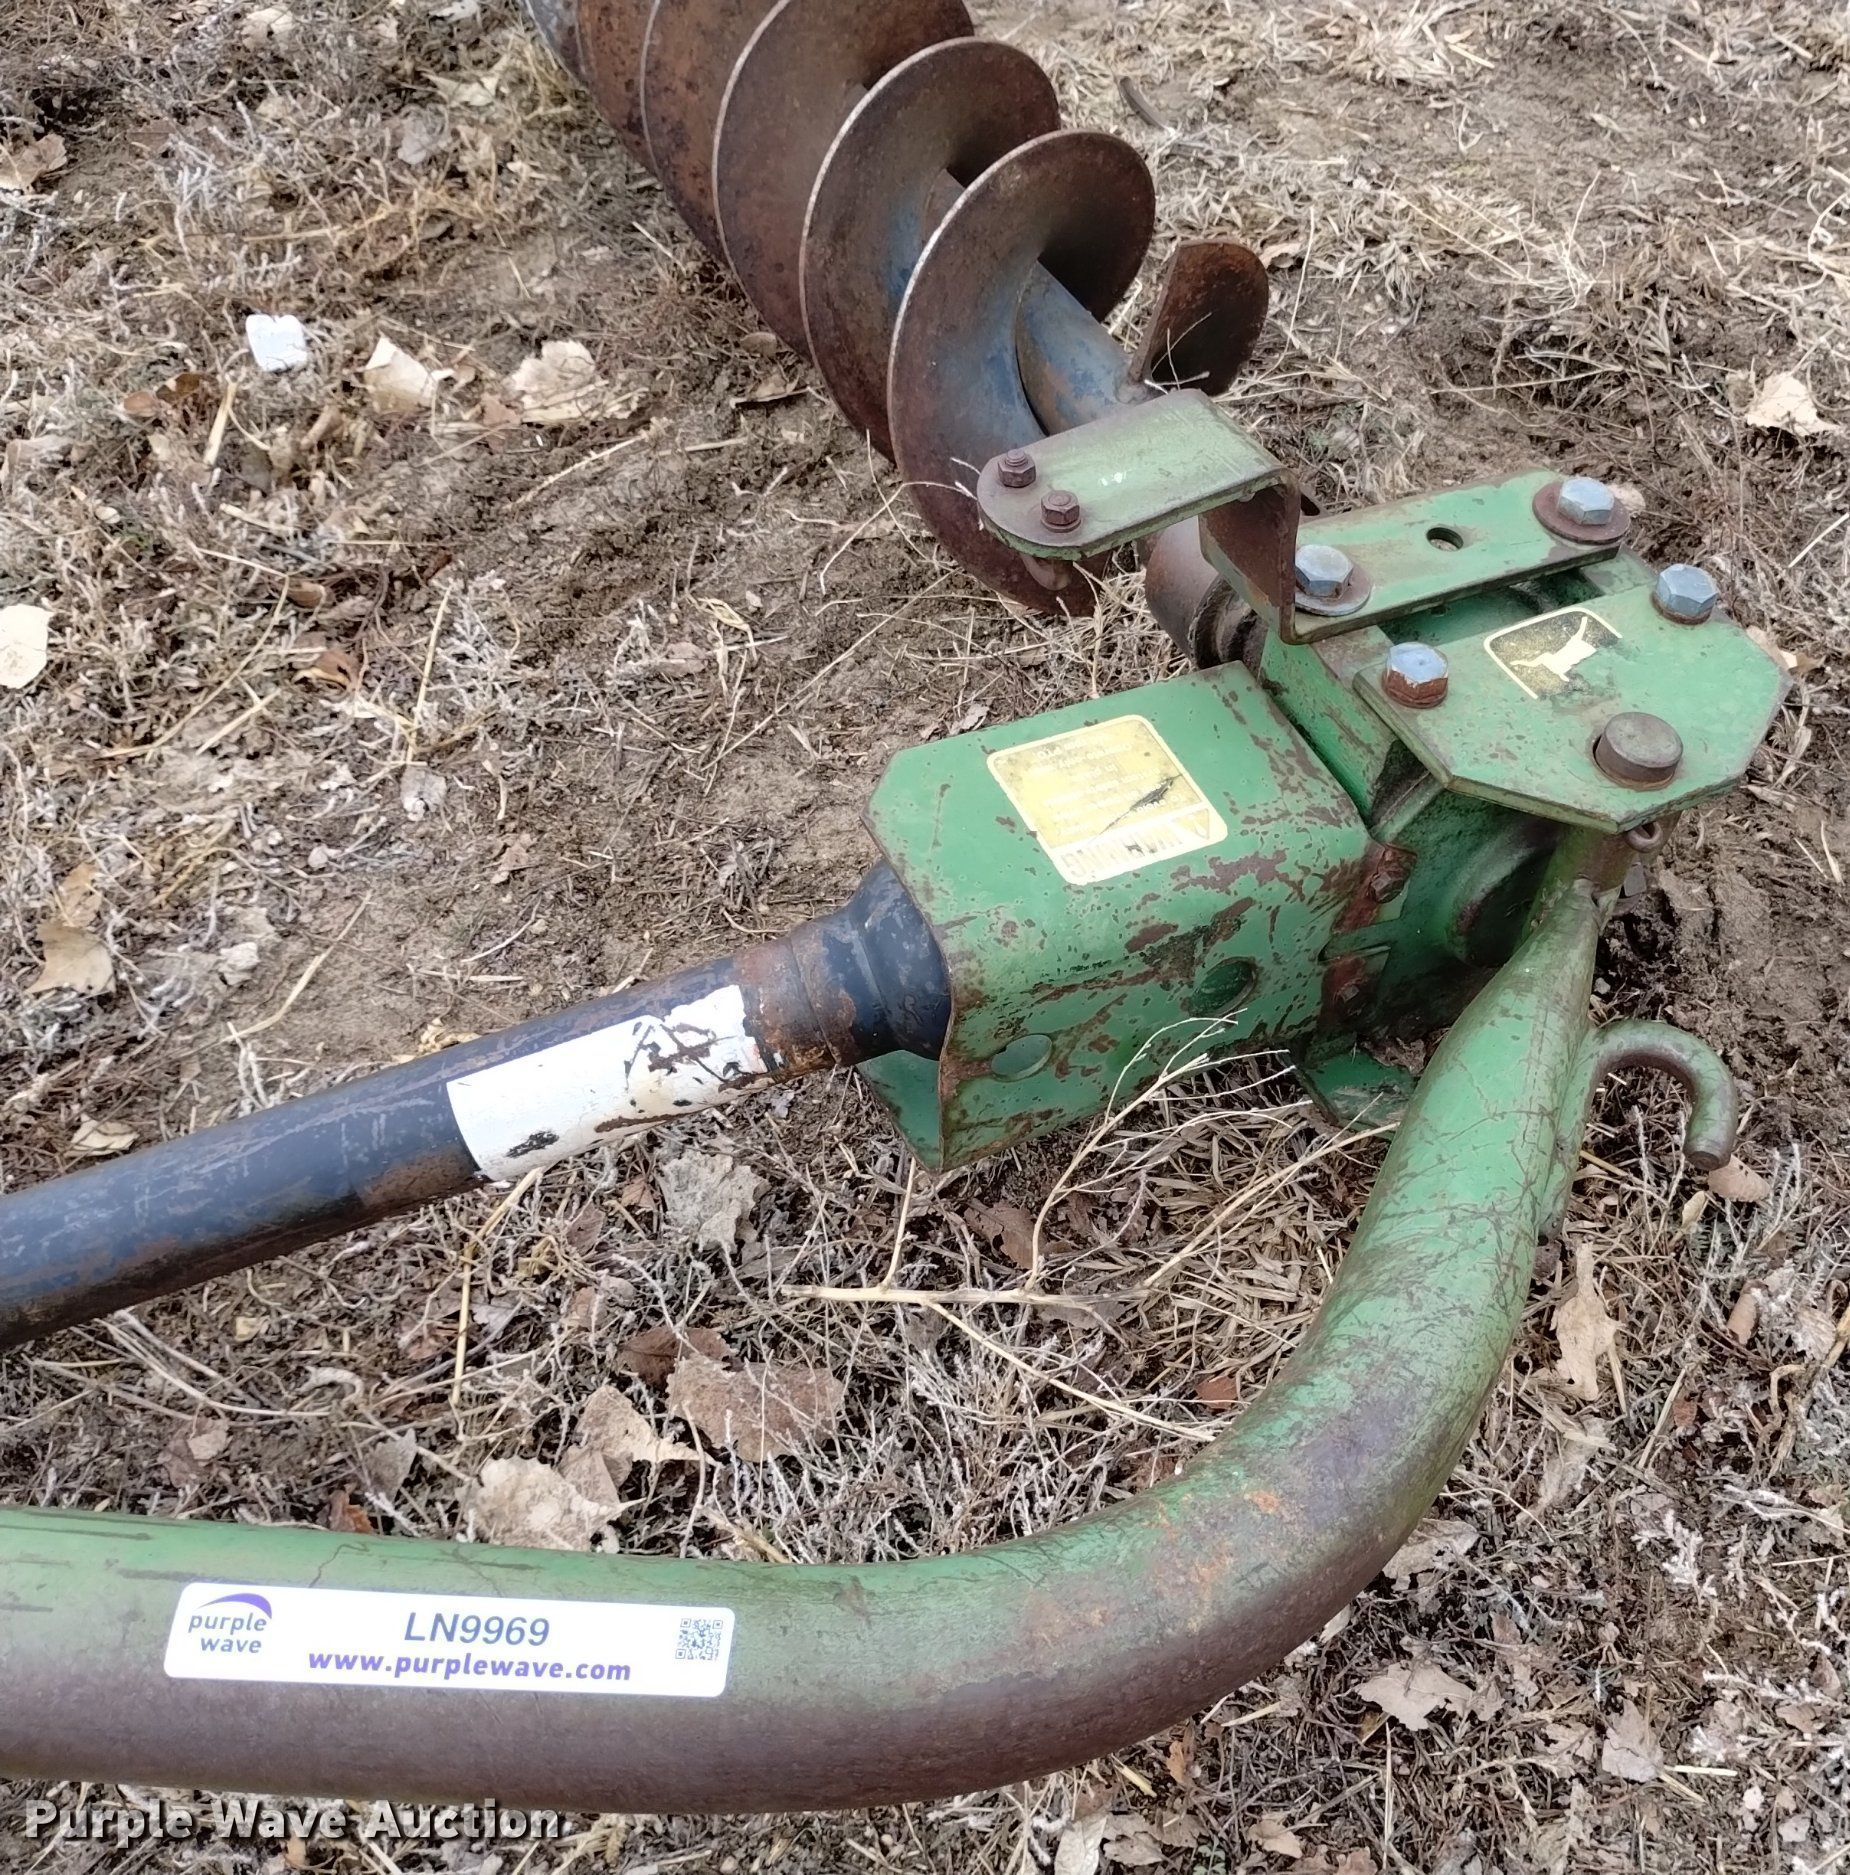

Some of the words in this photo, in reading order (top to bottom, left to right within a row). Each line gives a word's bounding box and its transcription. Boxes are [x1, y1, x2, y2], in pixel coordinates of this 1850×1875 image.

[188, 1612, 267, 1636] purple
[404, 1612, 550, 1647] LN9969
[200, 1634, 262, 1655] wave
[308, 1652, 632, 1682] www.purplewave.com
